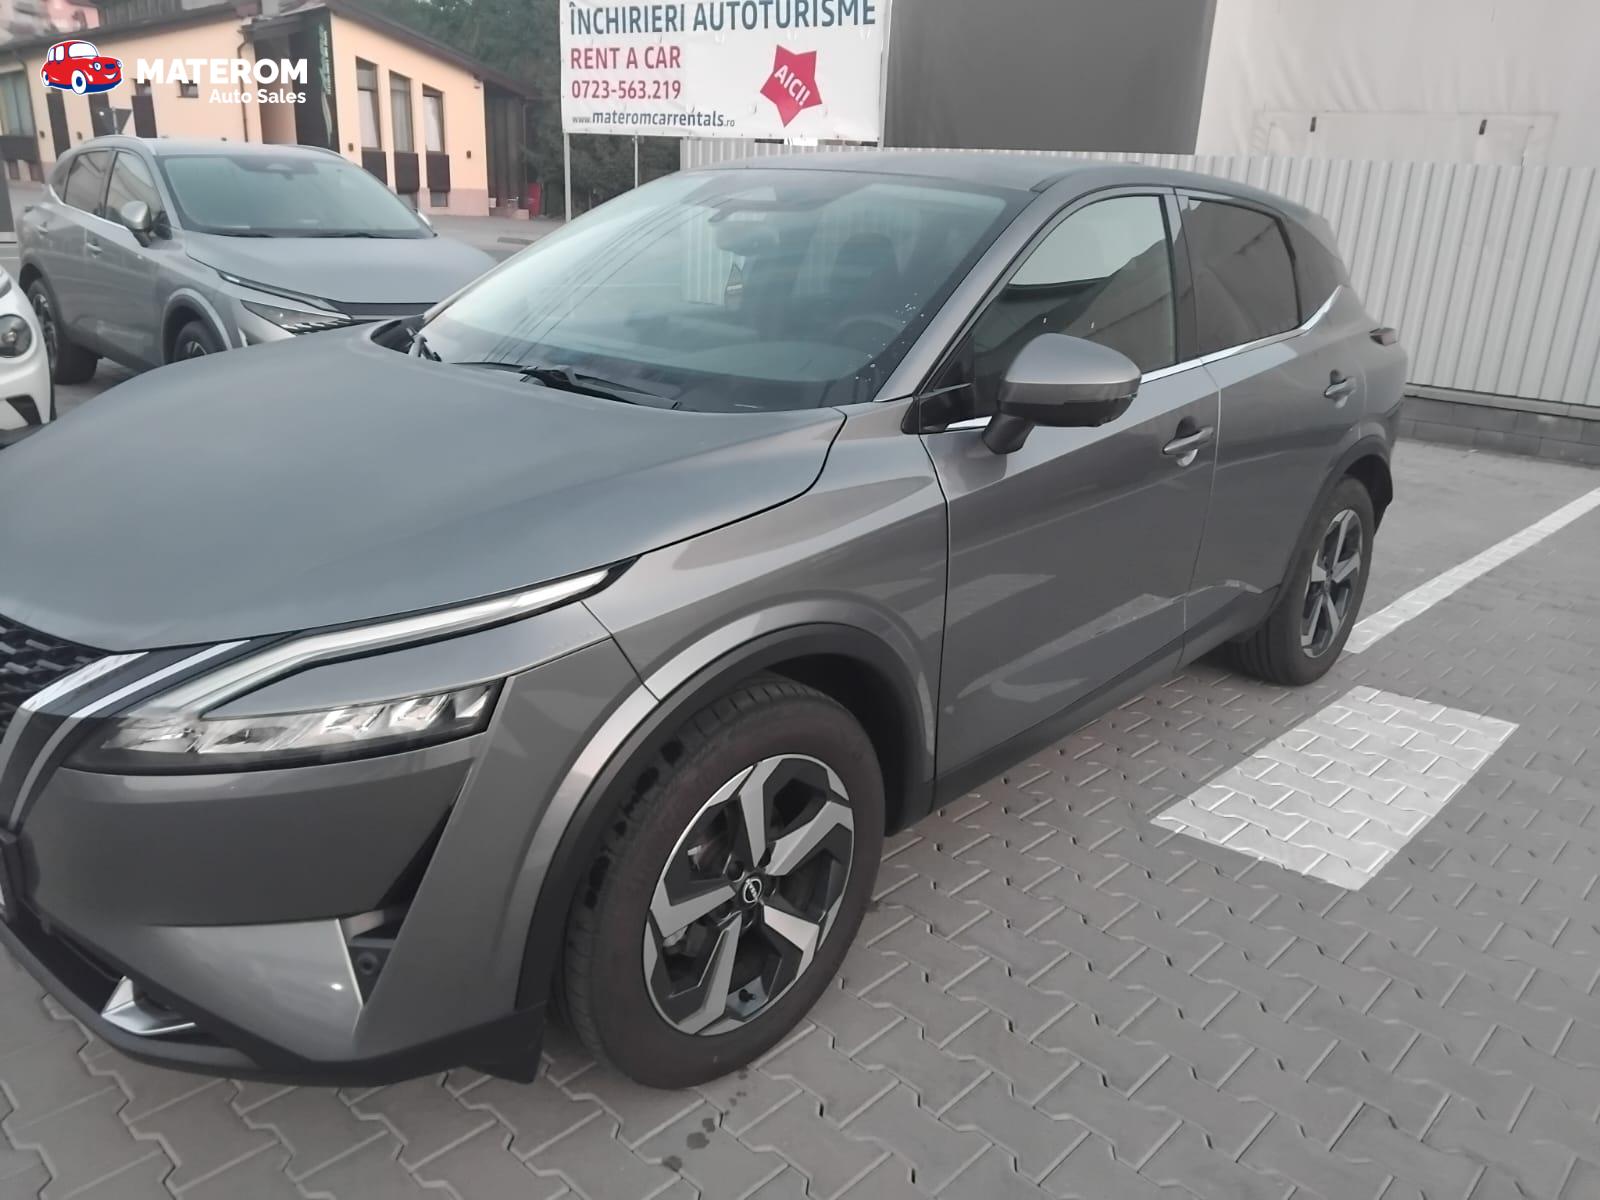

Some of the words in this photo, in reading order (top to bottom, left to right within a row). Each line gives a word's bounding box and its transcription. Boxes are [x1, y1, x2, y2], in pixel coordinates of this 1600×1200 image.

[569, 1, 685, 35] ÎNCHIRIERI
[693, 0, 876, 31] AUTOTURISME
[571, 47, 620, 69] RENT
[626, 47, 638, 69] A
[644, 45, 681, 69] CAR
[571, 80, 681, 99] 0723-563.219
[774, 64, 811, 106] AICI!
[572, 110, 735, 127] www.materomcarrentals.ro
